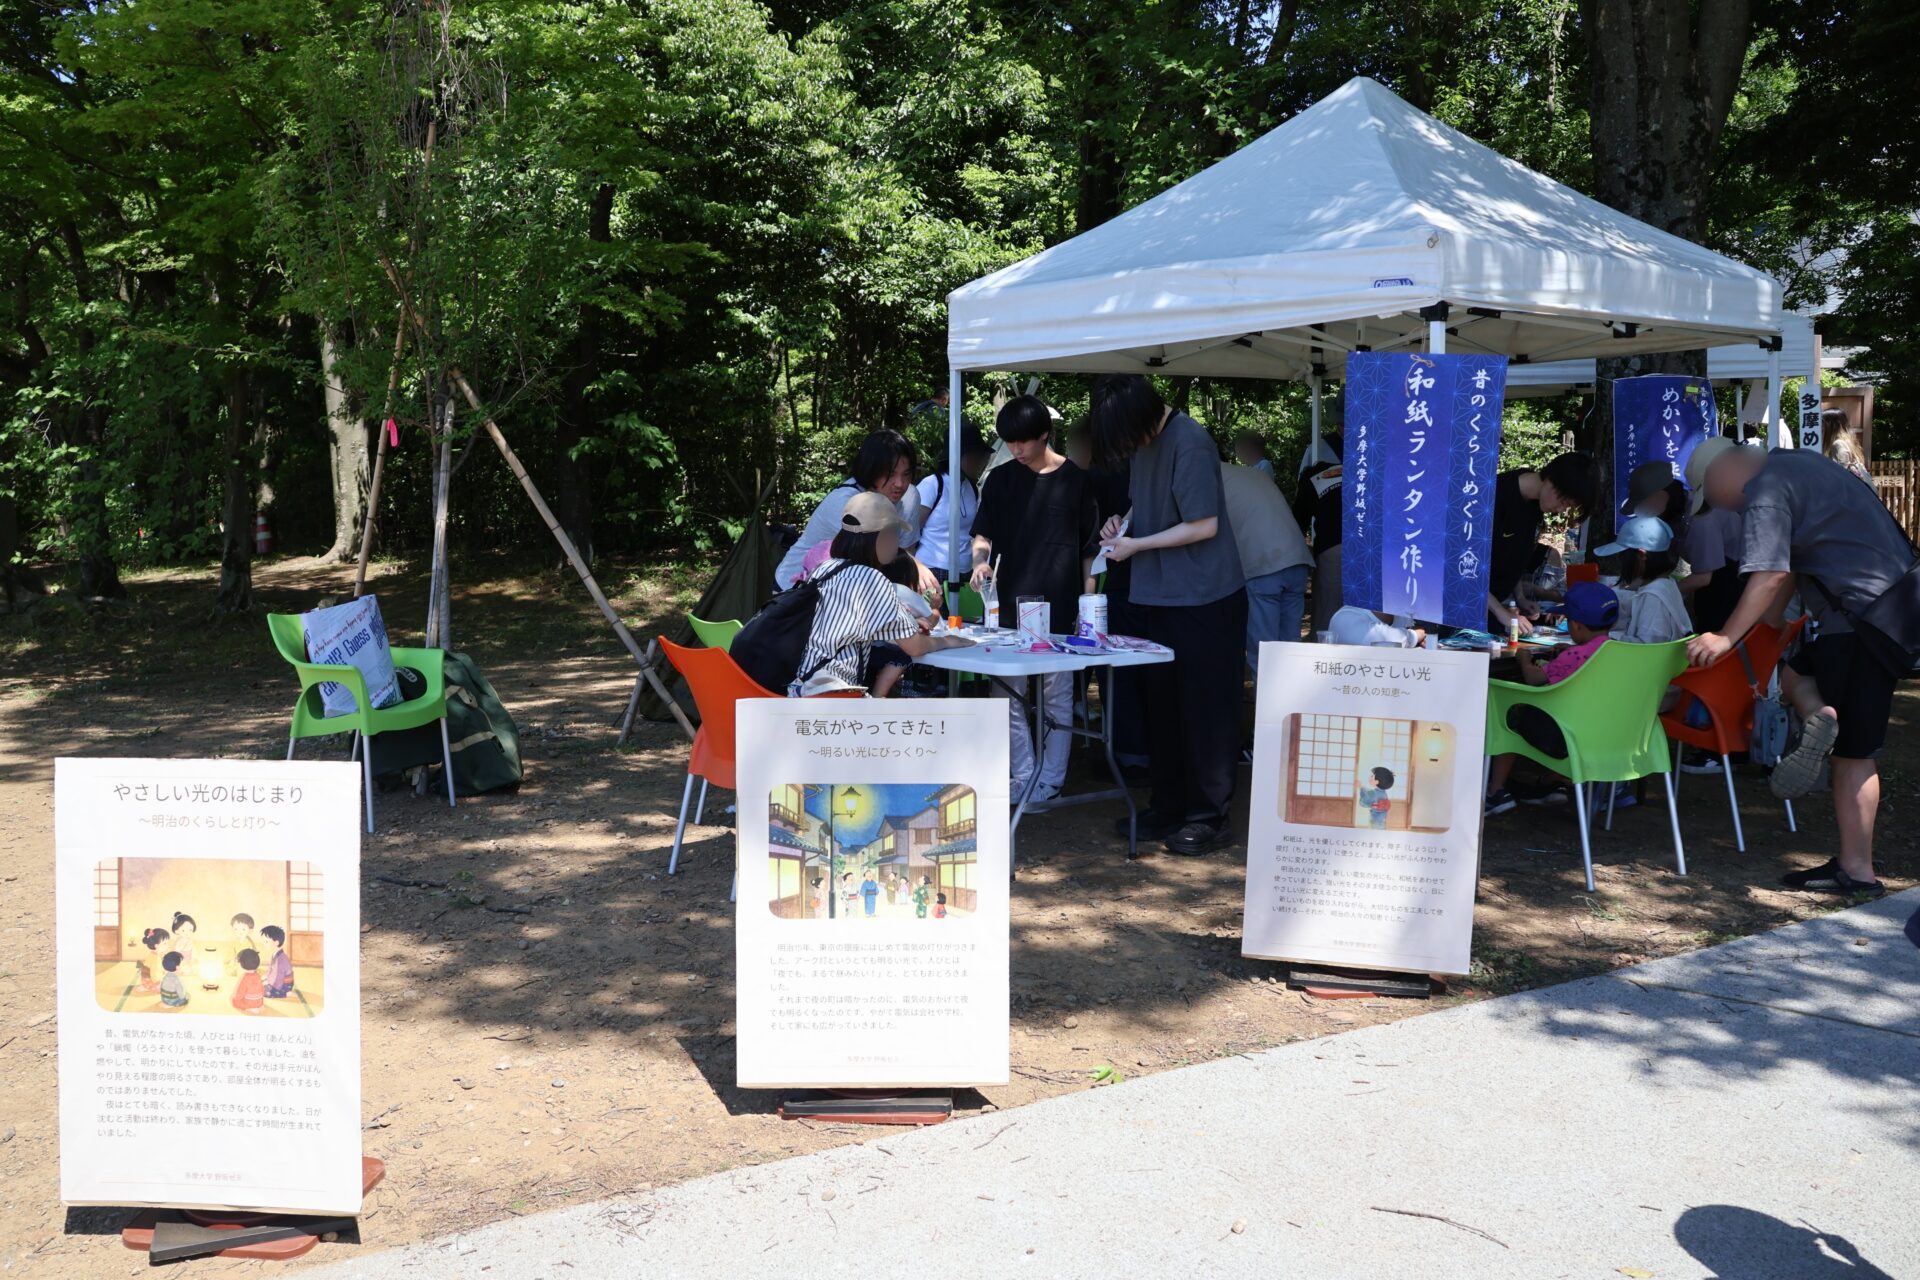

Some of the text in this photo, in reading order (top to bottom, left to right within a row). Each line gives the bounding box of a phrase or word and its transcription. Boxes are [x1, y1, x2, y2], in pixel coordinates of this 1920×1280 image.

[1801, 392, 1820, 447] 多摩め
[1462, 368, 1491, 542] 昔のくらしめぐり
[1354, 424, 1368, 538] 多摩大学野坂ゼミ
[1400, 367, 1436, 607] 和紙ランタン作り
[342, 628, 371, 657] Guess
[1313, 660, 1432, 682] 和紙のやさしい光
[794, 718, 947, 737] 電気がやってきた！
[112, 783, 305, 805] やさしい光のはじまり
